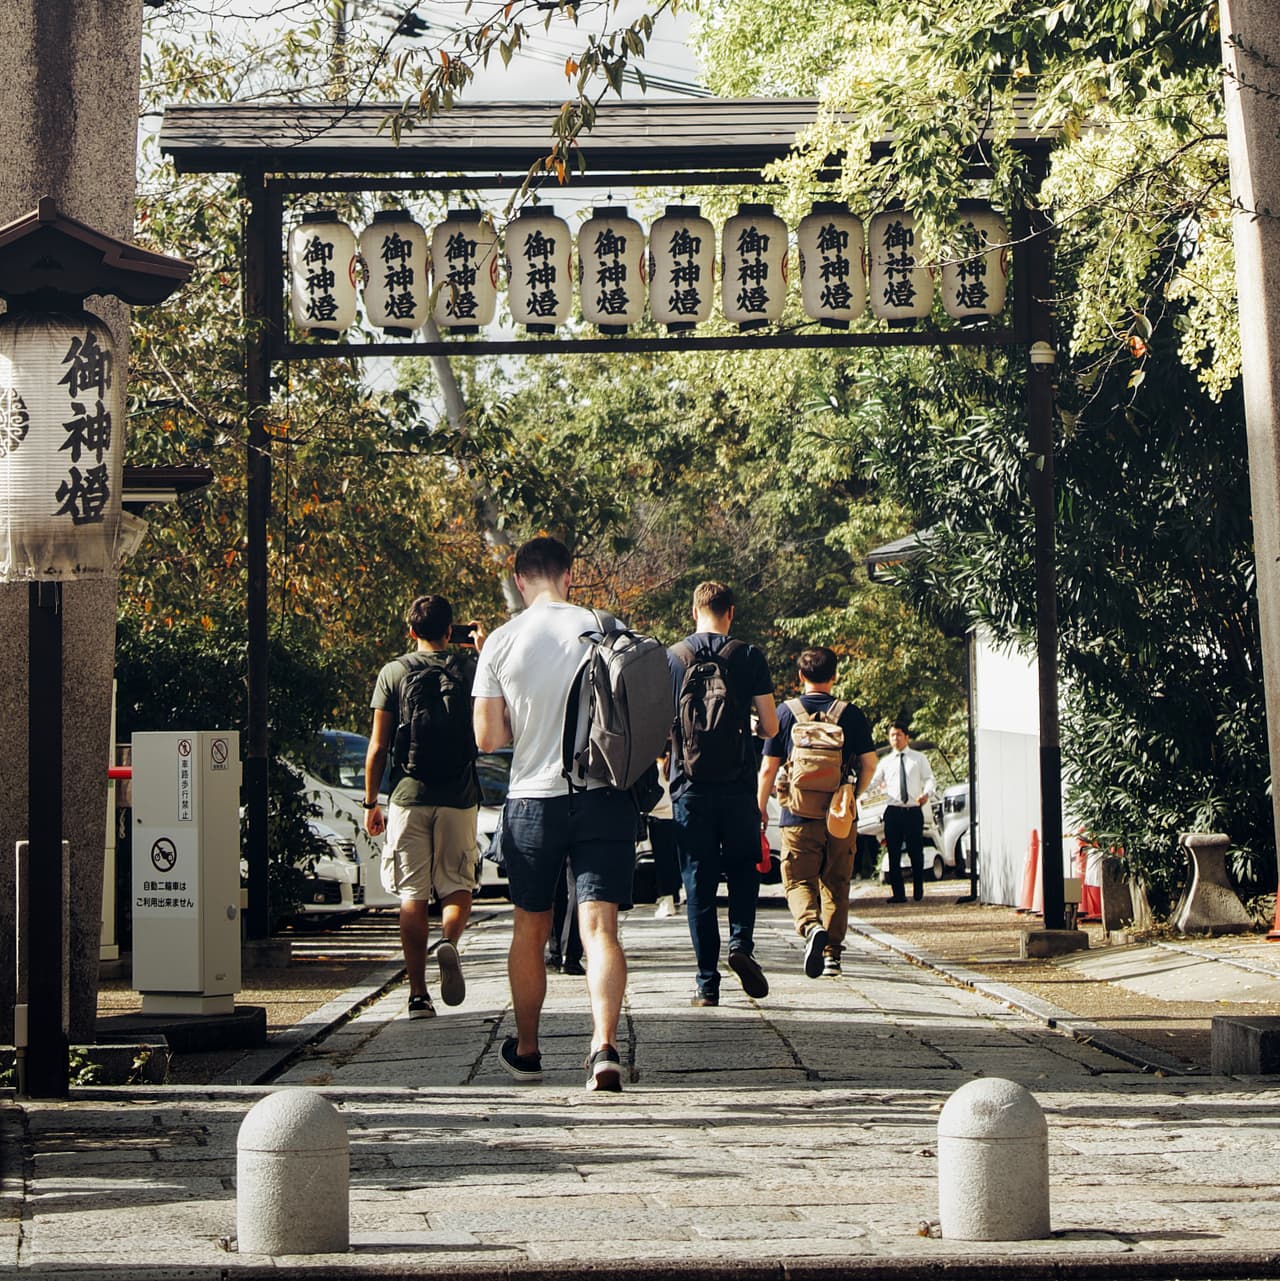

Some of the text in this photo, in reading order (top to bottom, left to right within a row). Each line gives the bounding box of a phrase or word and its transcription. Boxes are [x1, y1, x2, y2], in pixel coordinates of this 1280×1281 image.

[303, 235, 338, 321] 御神燈
[381, 232, 417, 319] 御神燈
[523, 230, 559, 317] 御神燈
[594, 228, 630, 316] 御神燈
[669, 227, 702, 316] 御神燈
[736, 225, 770, 314] 御神燈
[816, 222, 853, 311] 御神燈
[50, 331, 112, 525] 御神燈
[136, 897, 195, 908] ご利用出来ません
[143, 881, 187, 891] 自動二輪車は
